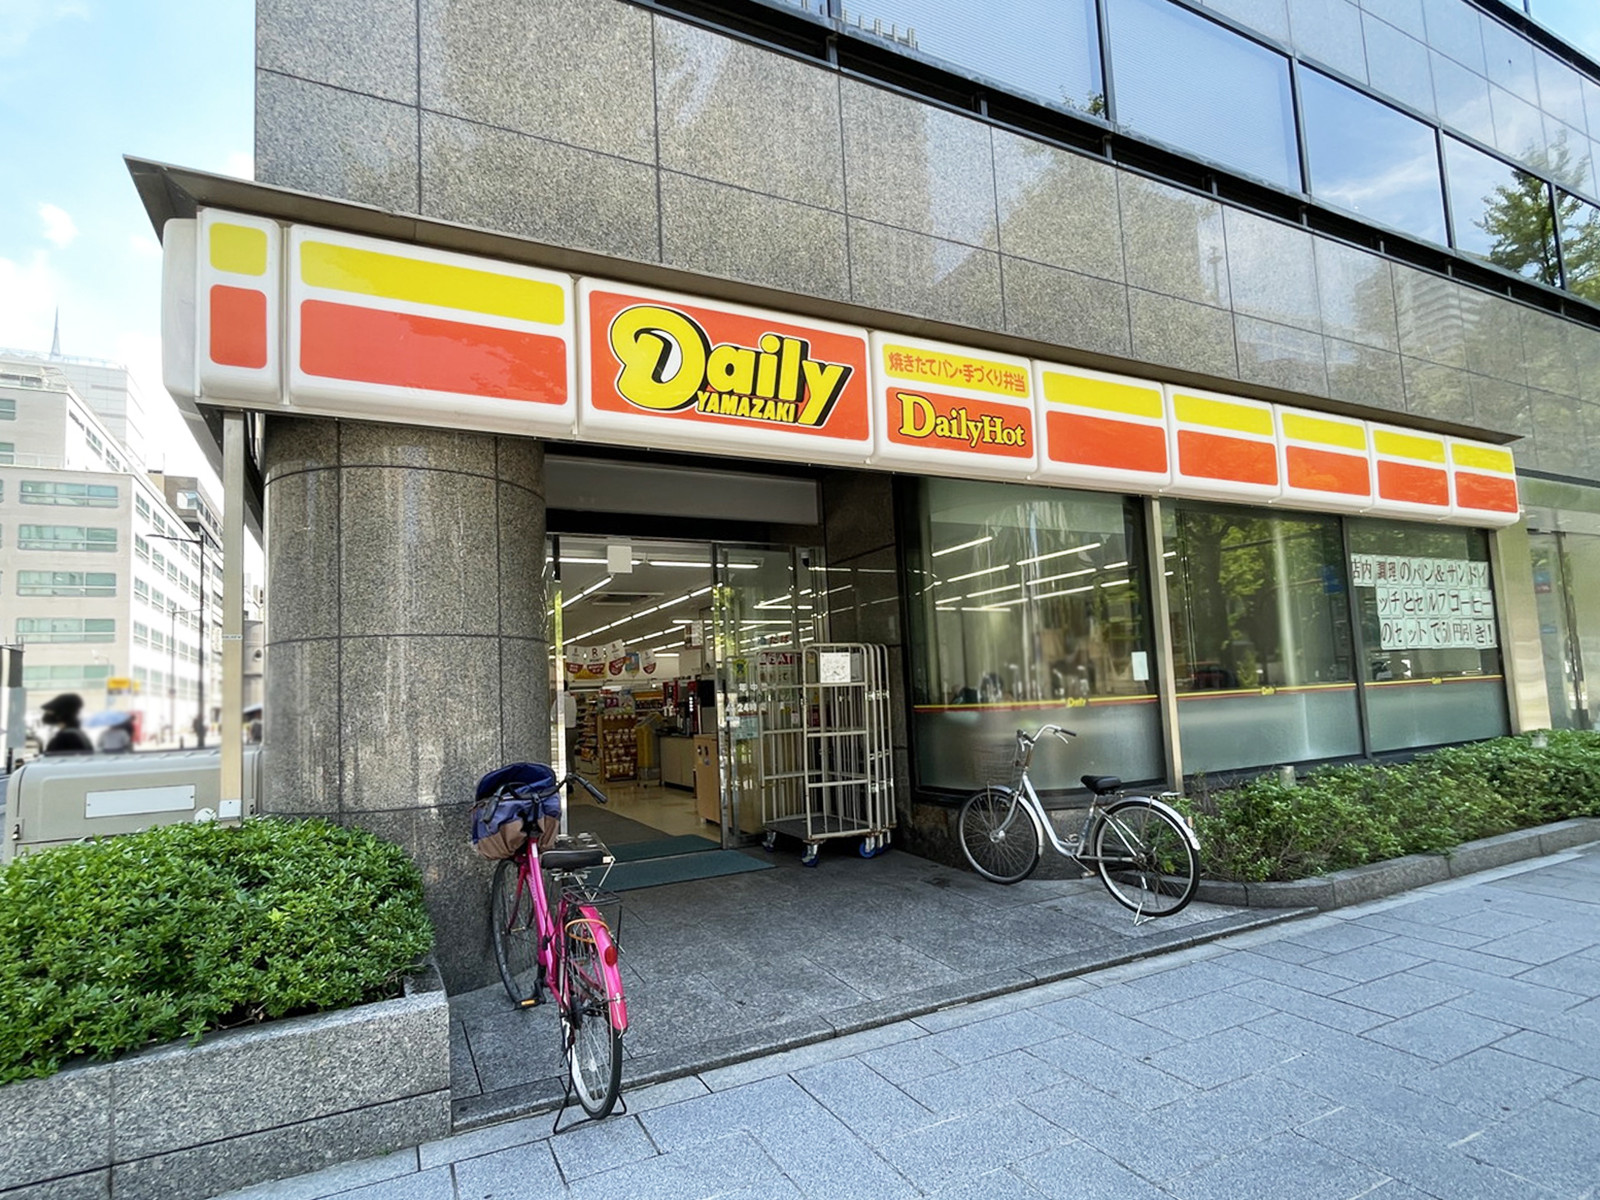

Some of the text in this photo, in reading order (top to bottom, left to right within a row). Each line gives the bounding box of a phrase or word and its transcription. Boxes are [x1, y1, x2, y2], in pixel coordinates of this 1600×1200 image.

[610, 306, 849, 426] Daily
[888, 352, 1026, 393] 焼きたてパン・手づくり弁当
[697, 390, 797, 423] YAMAZAKI
